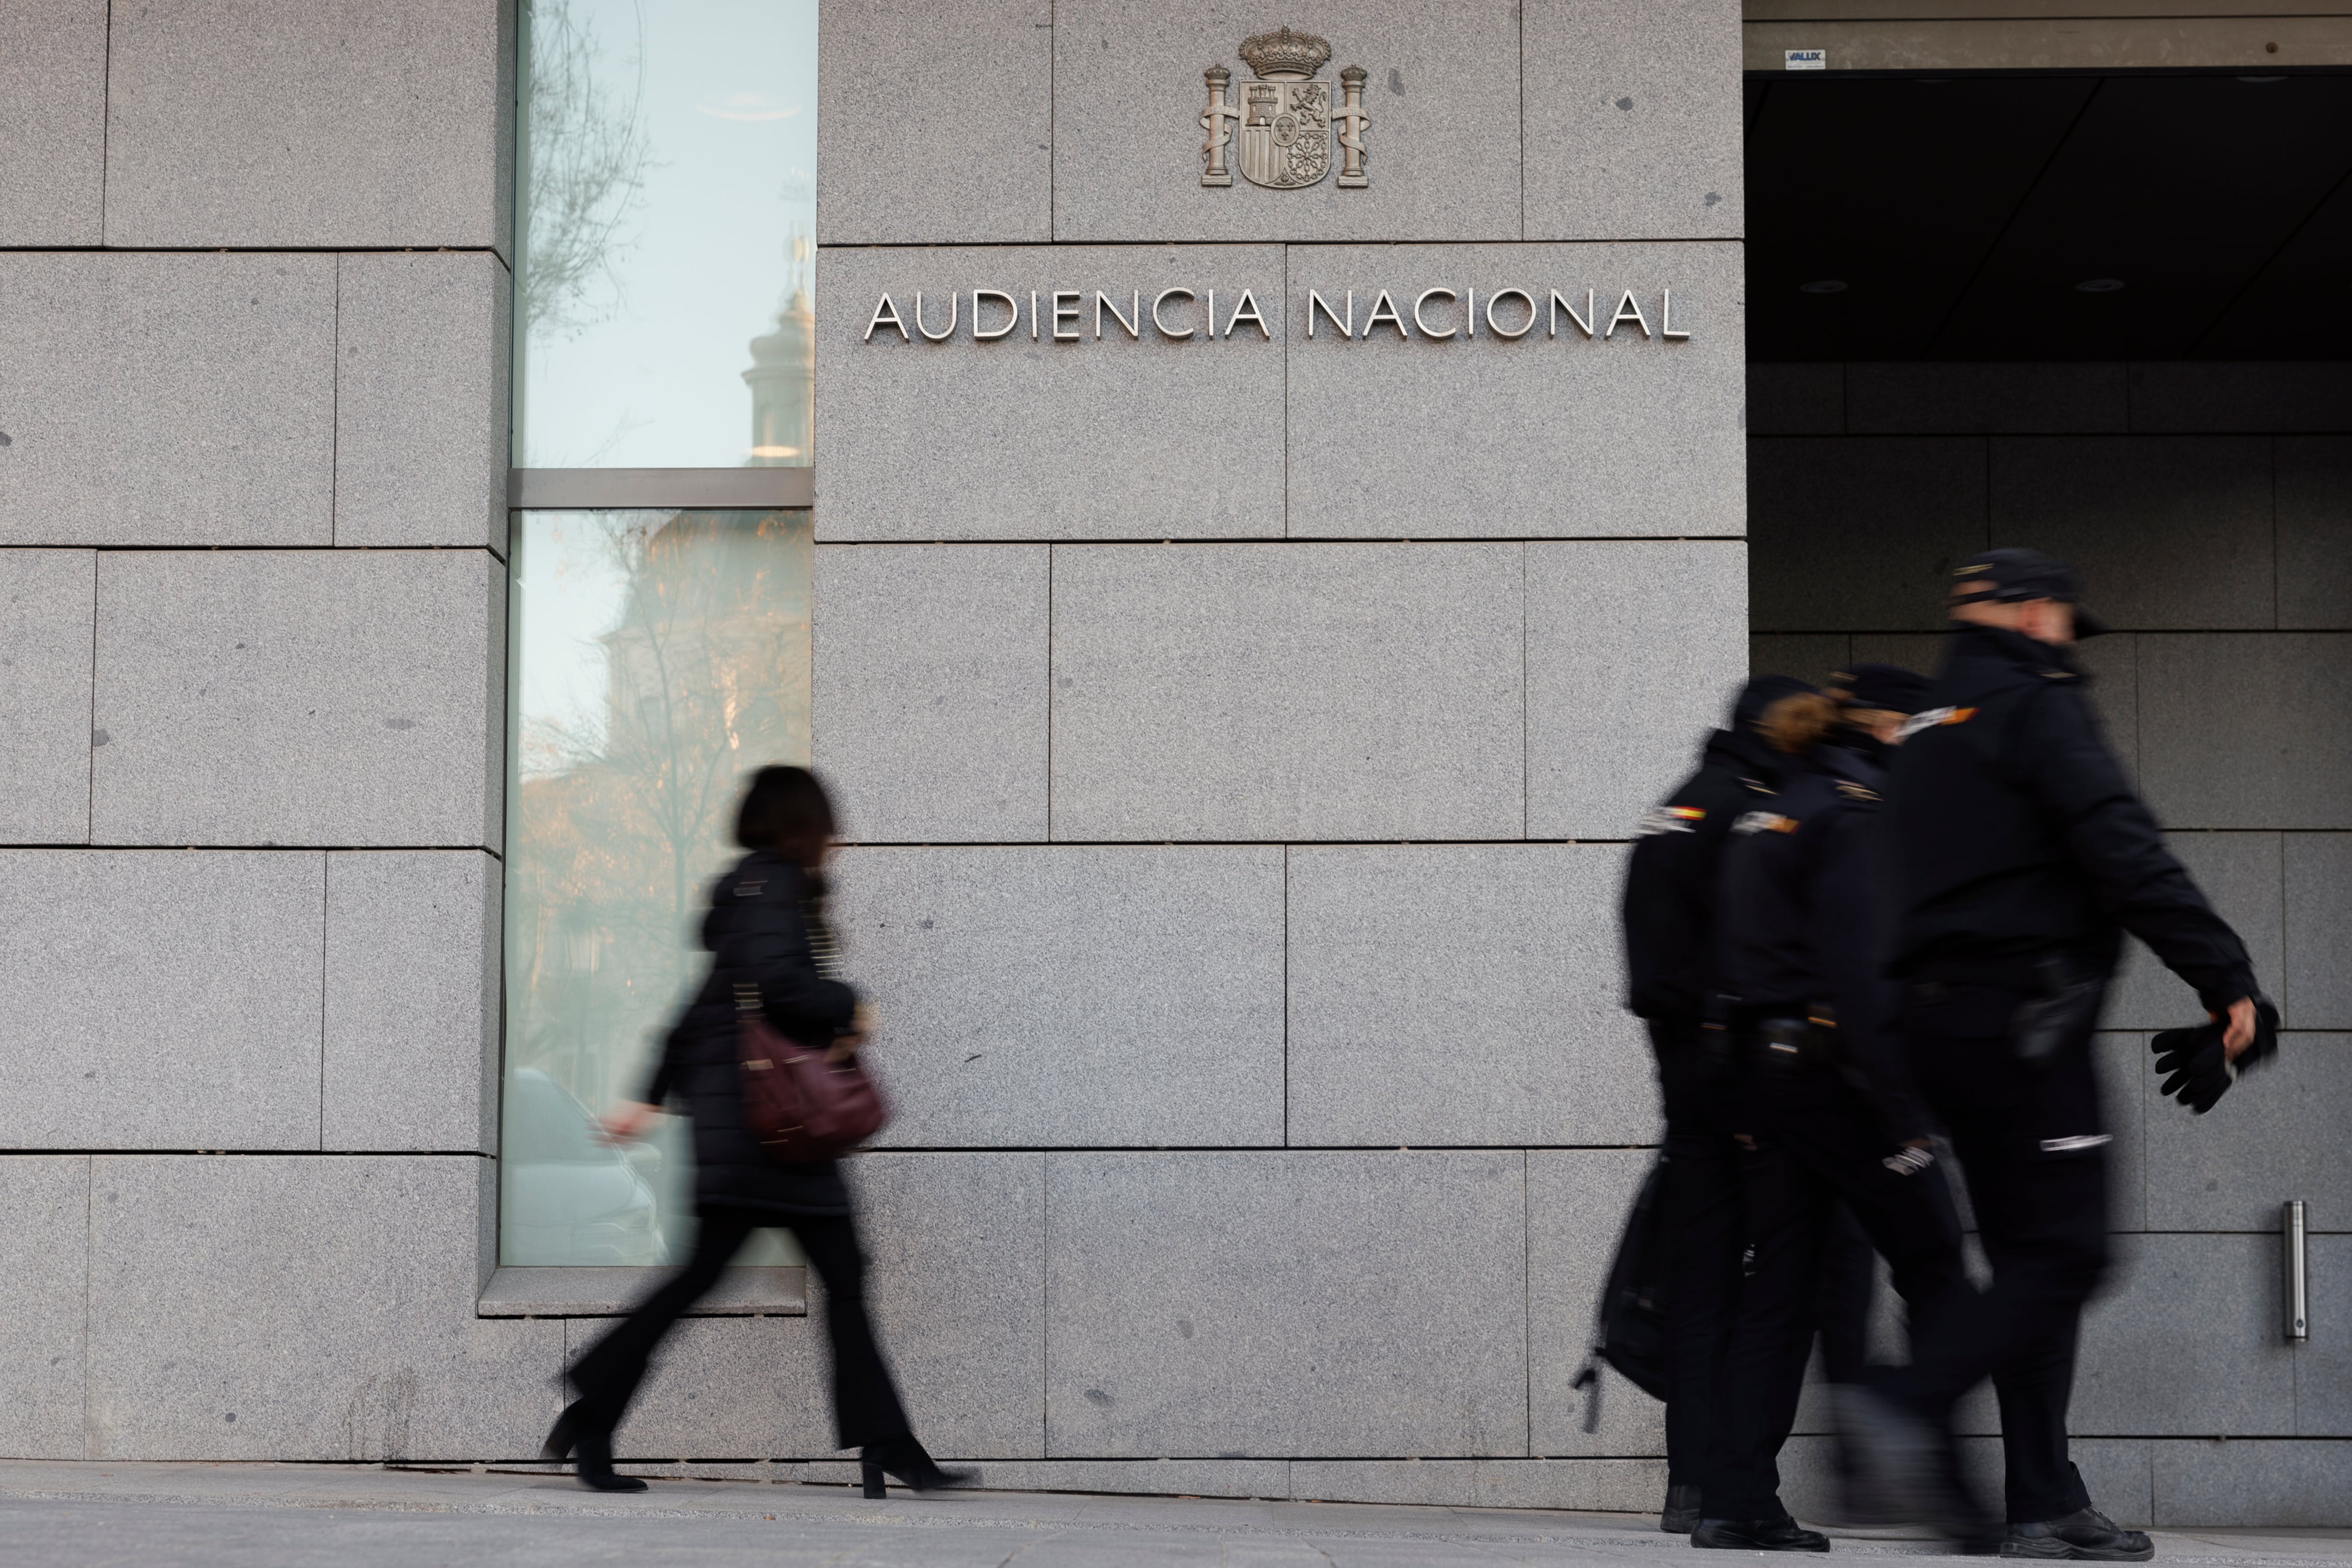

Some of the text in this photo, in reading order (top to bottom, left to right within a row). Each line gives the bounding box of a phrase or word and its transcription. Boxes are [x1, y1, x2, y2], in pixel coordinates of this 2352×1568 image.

[1788, 52, 1821, 61] VALUX
[864, 288, 1690, 341] AUDIENCIA NACIONAL
